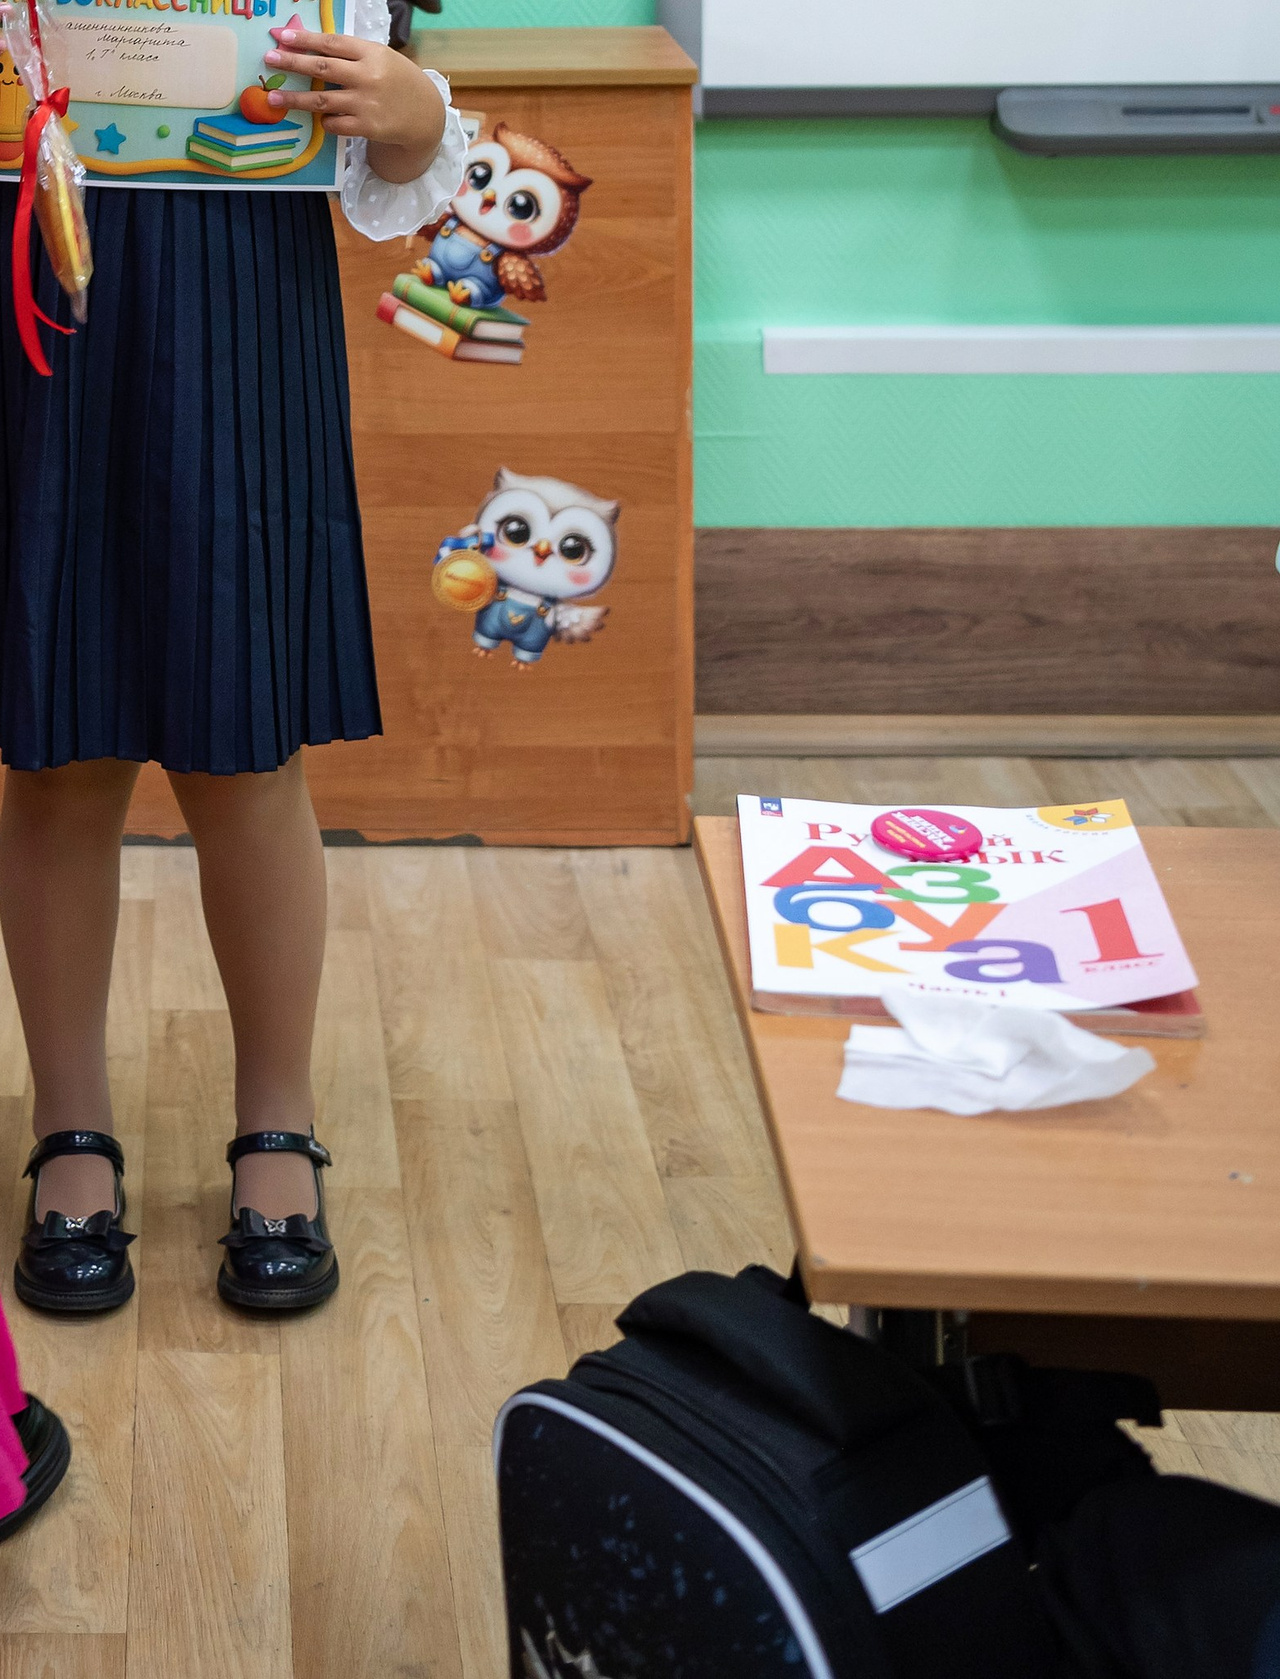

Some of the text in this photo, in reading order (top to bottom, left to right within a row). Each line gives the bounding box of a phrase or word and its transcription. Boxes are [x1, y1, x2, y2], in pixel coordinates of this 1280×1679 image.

[118, 51, 161, 62] класс
[110, 85, 167, 100] Москва
[1061, 897, 1164, 966] 1
